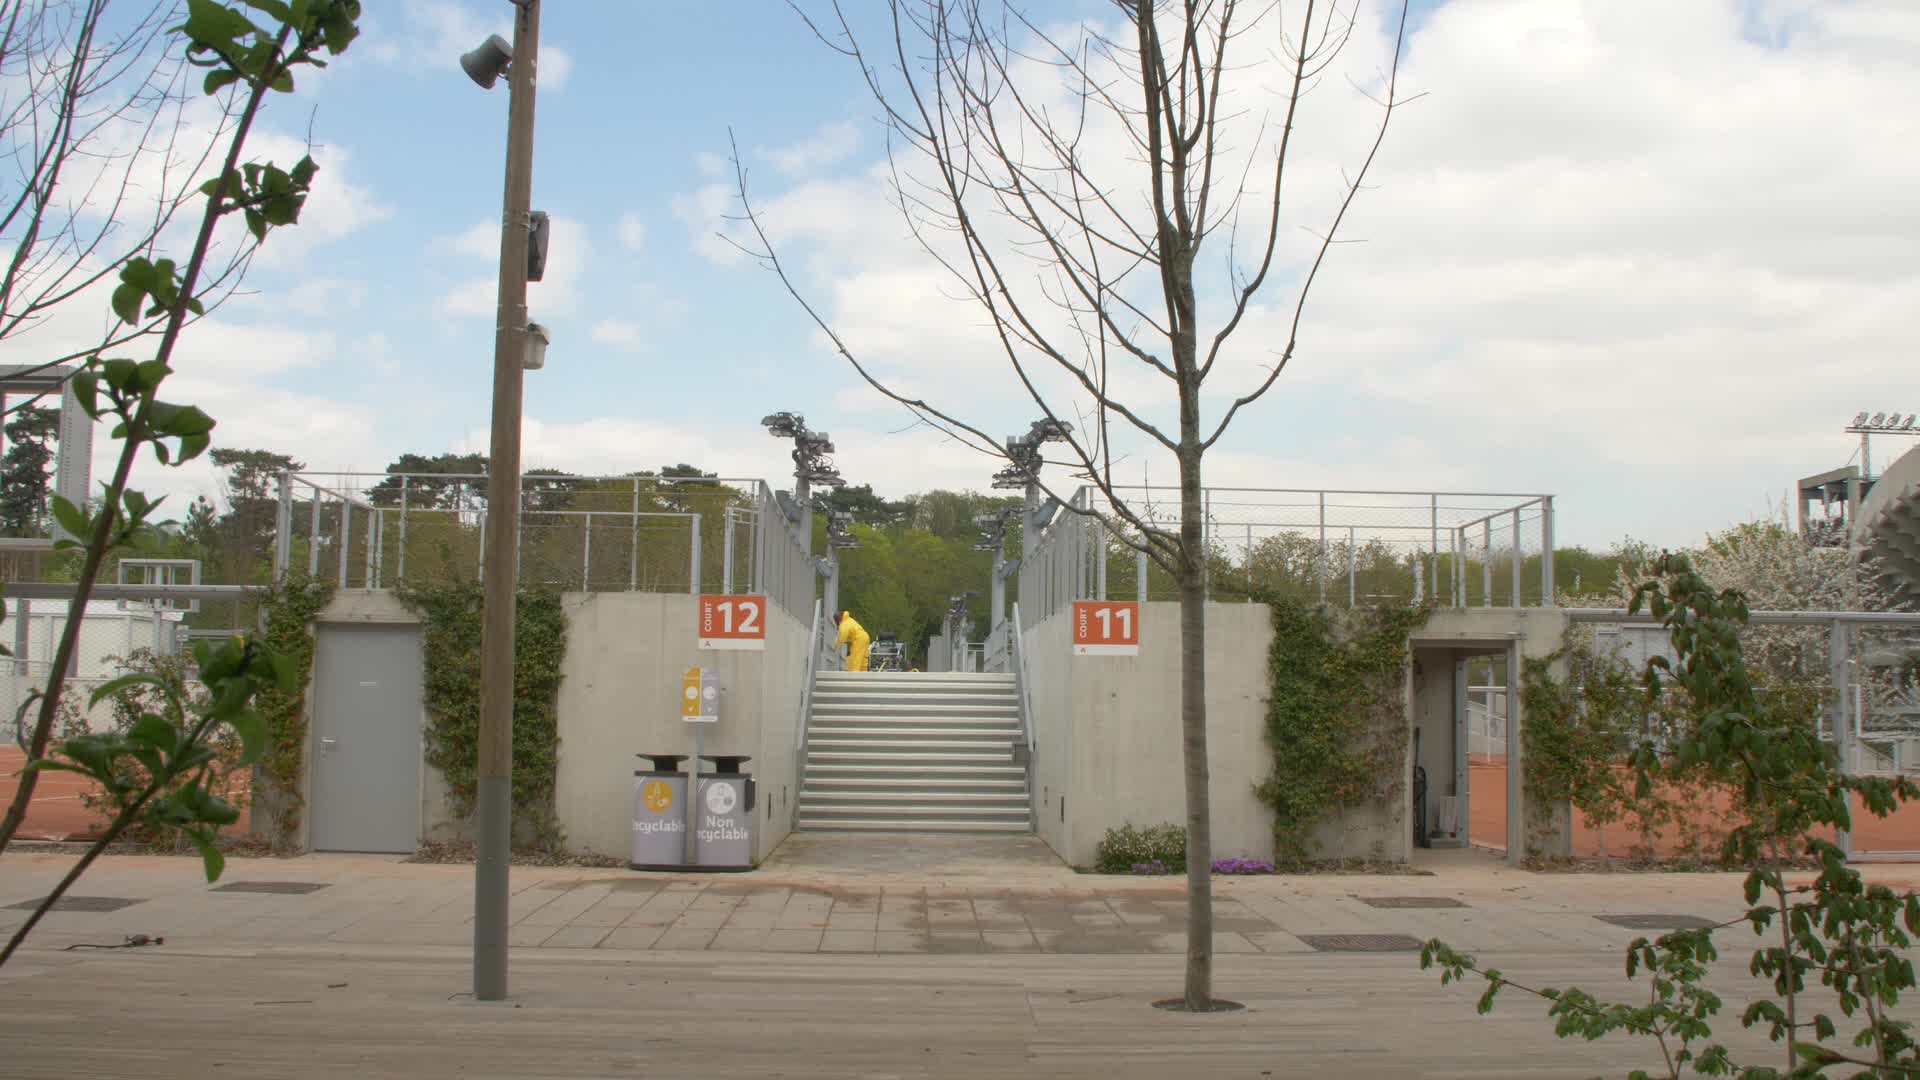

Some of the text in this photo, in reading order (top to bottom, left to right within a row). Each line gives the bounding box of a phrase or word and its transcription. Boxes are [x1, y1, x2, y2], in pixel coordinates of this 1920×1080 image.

[704, 601, 712, 633] COURT
[717, 601, 760, 633] 12
[1095, 607, 1131, 639] 11
[706, 815, 734, 828] Non
